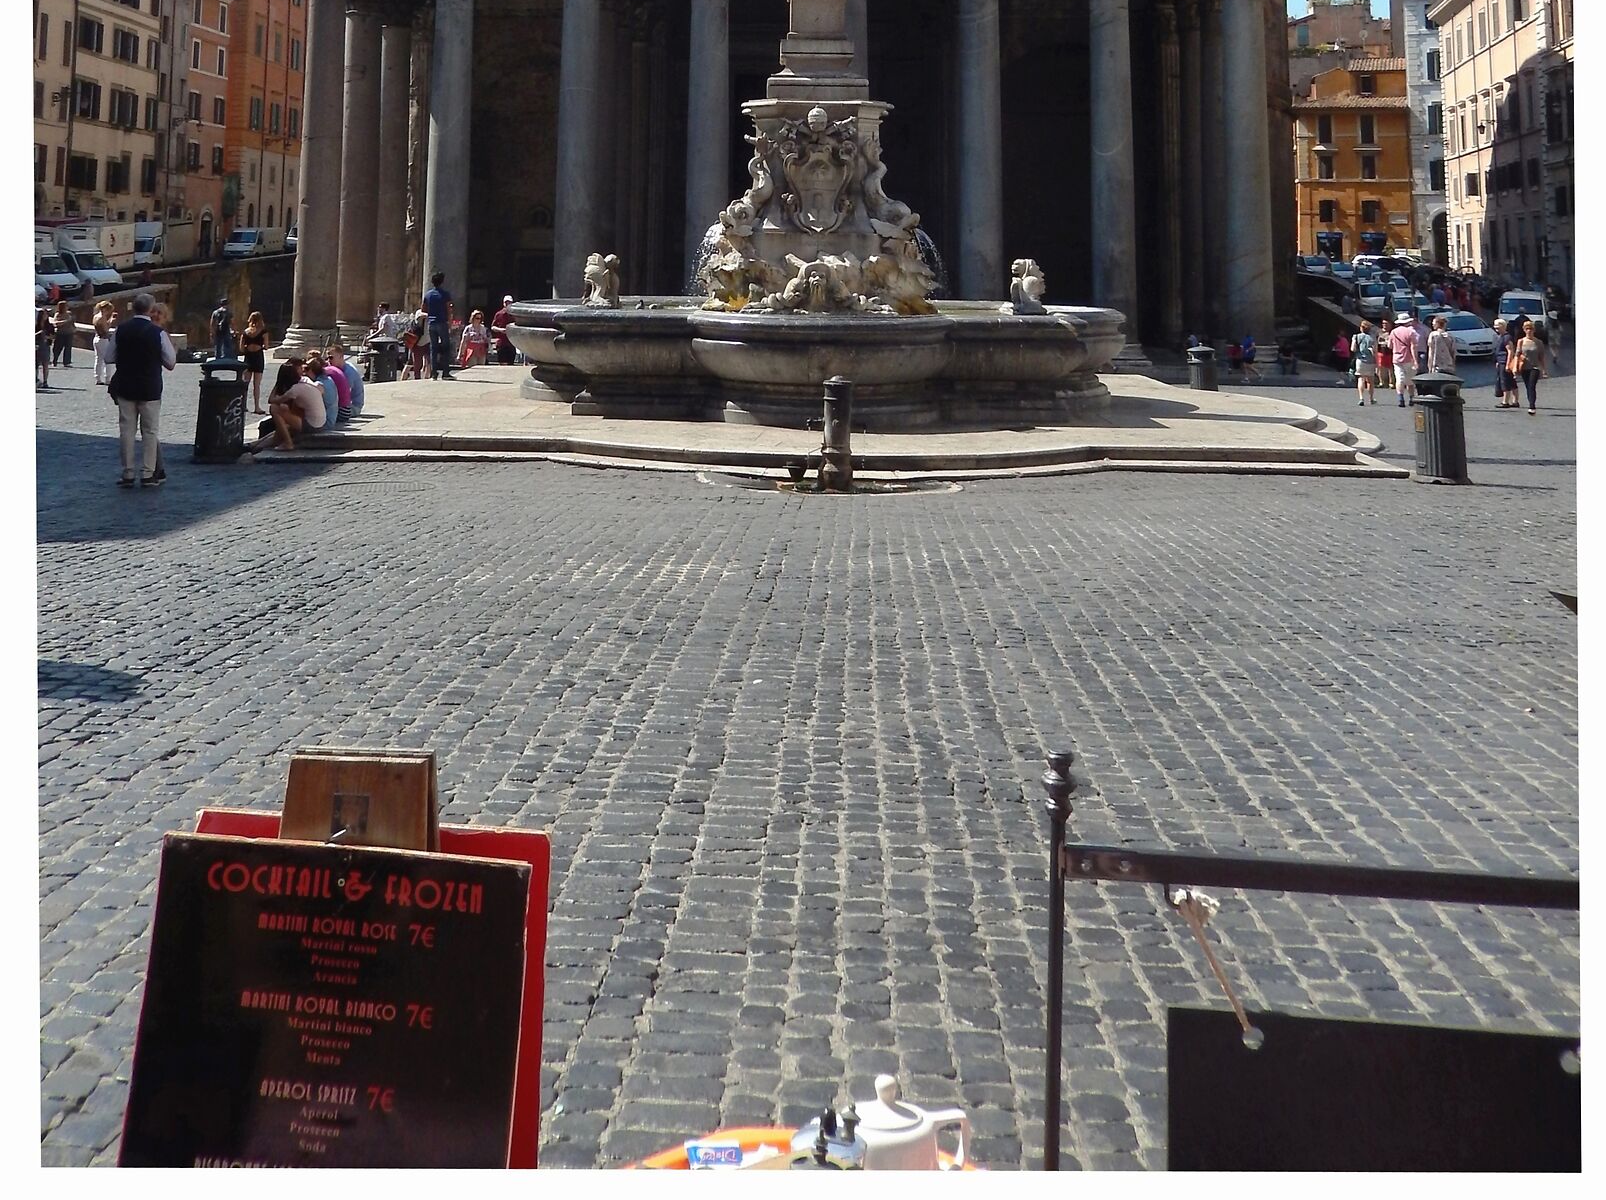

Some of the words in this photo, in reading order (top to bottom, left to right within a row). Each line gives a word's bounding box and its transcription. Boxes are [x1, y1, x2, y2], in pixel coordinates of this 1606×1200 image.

[208, 862, 331, 898] COCKTAIL
[344, 871, 372, 901] &
[384, 874, 483, 914] FROZEN
[257, 912, 308, 932] MARTINI
[312, 917, 355, 936] ROYAL
[408, 924, 435, 948] 7€
[302, 937, 344, 951] Martini
[311, 953, 360, 969] Prosecco
[240, 991, 291, 1012] MARTINI
[295, 996, 339, 1016] ROYAL
[345, 1001, 397, 1021] BIANCO
[407, 1004, 434, 1029] 7€
[288, 1017, 331, 1031] Martini
[335, 1022, 372, 1035] bianco
[301, 1034, 350, 1049] Prosecco
[305, 1052, 341, 1066] Menta
[259, 1079, 312, 1100] APEROL
[318, 1084, 357, 1105] SPRITZ
[367, 1086, 395, 1112] 7€
[301, 1106, 339, 1121] Aperol
